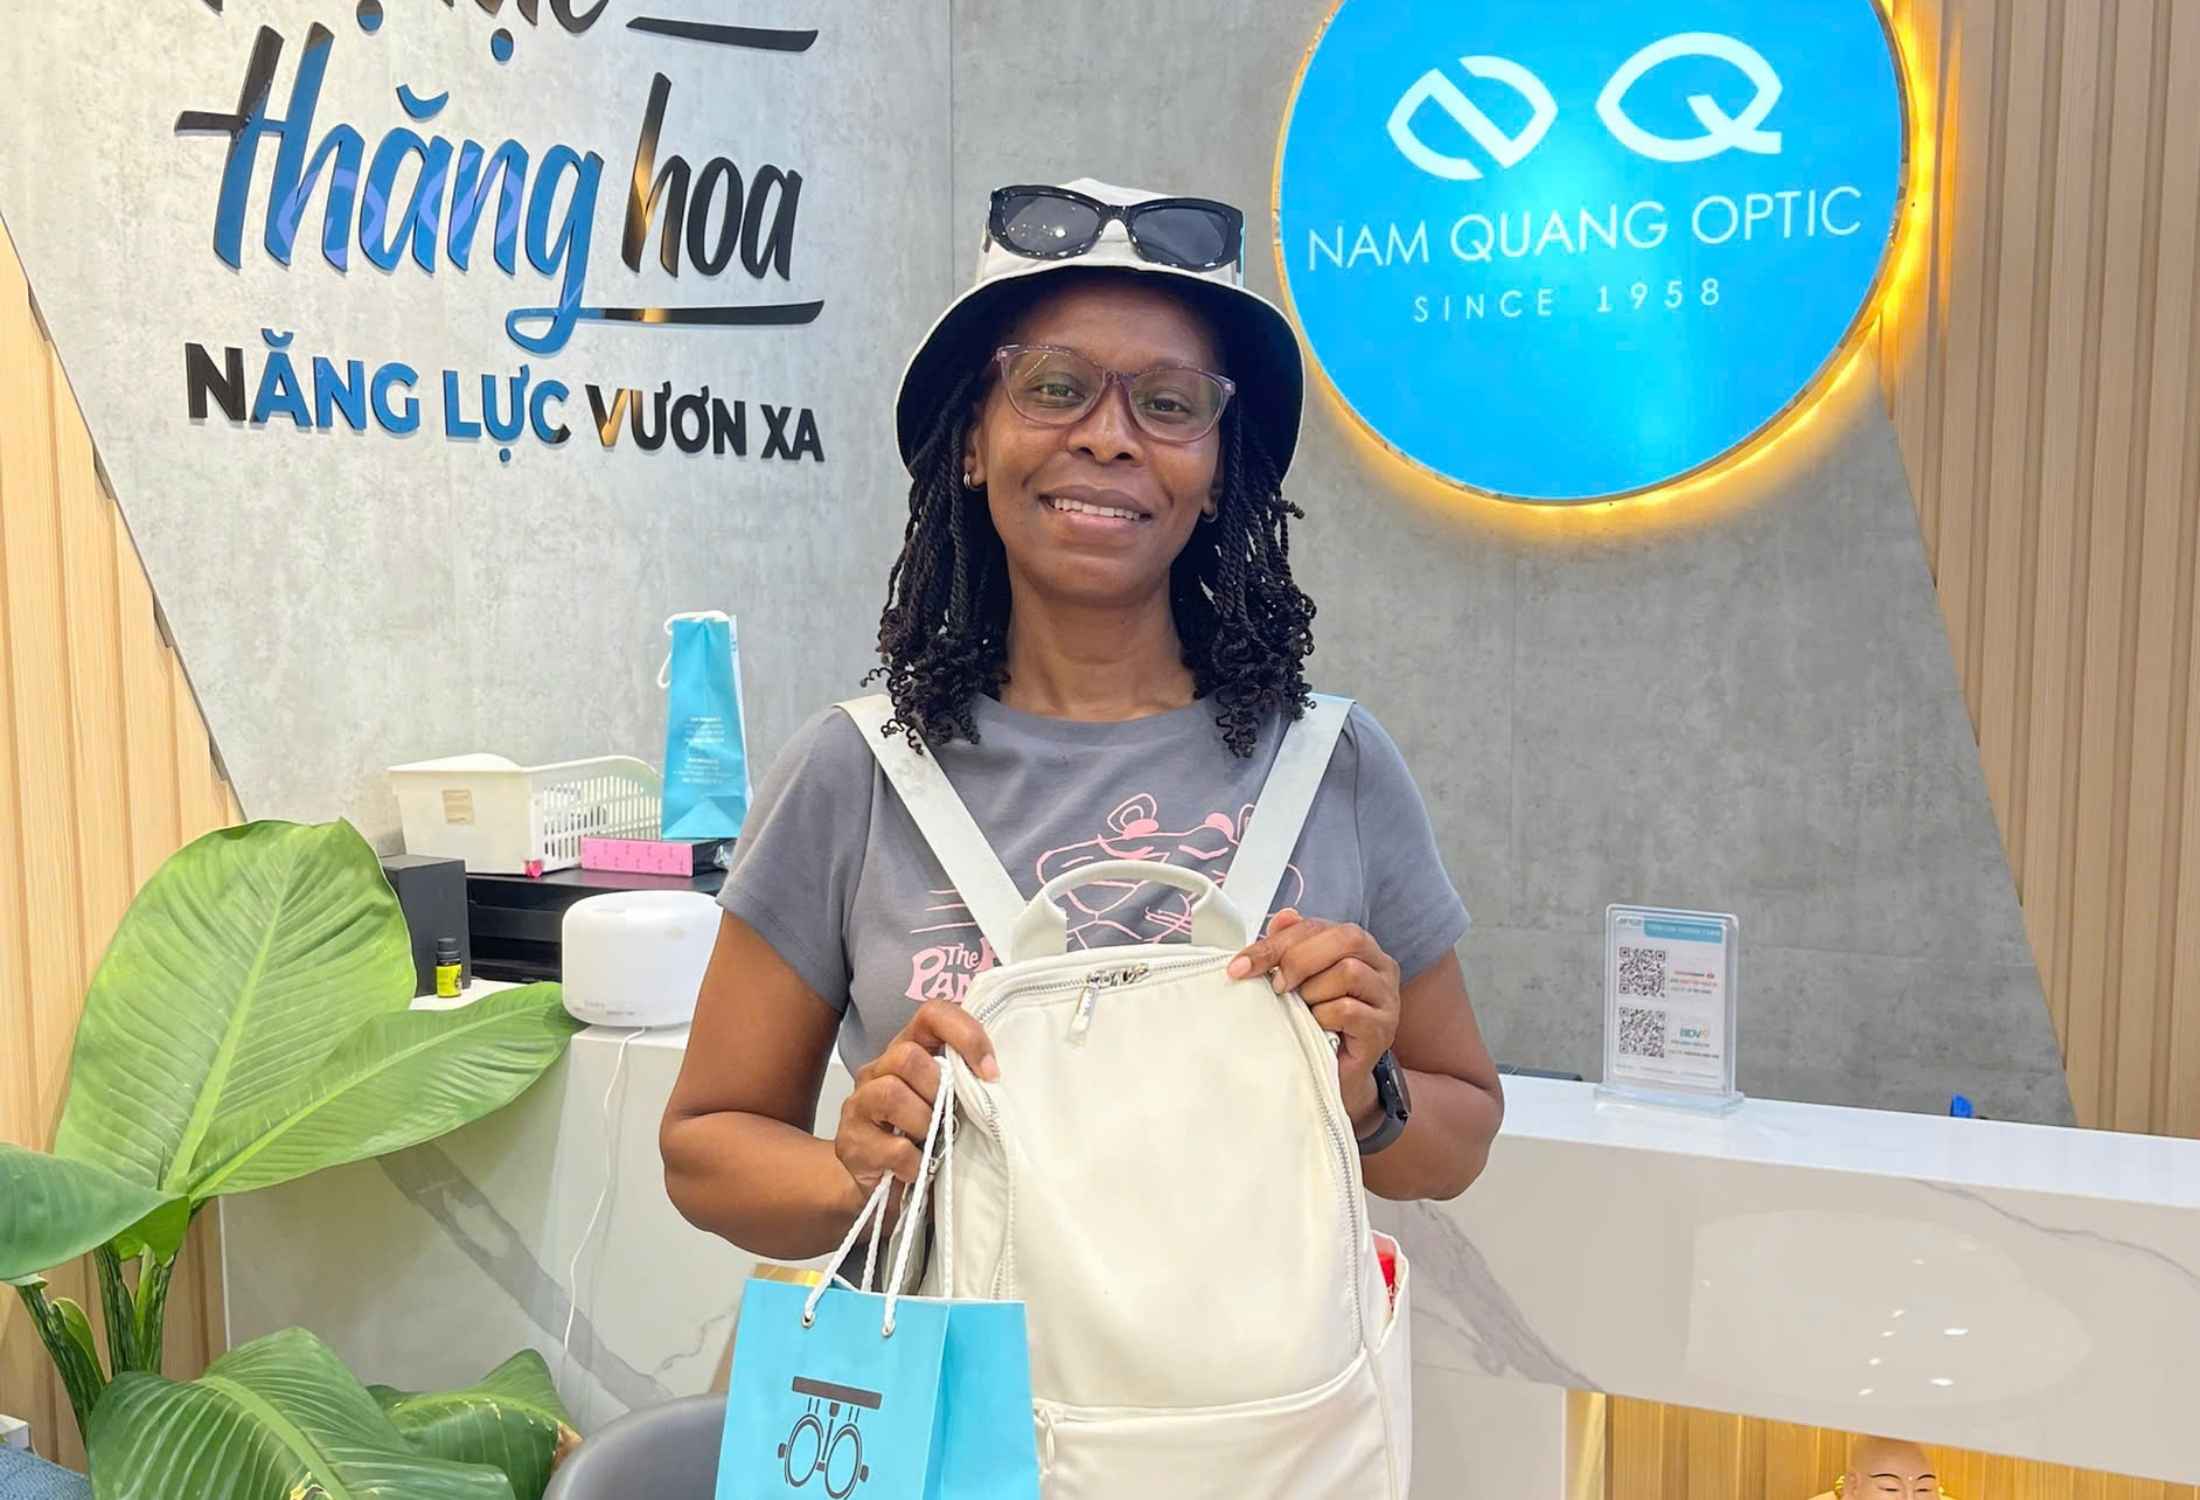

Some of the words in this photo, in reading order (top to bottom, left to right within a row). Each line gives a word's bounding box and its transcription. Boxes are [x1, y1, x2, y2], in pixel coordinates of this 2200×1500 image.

[622, 72, 803, 281] hoa
[1308, 220, 1430, 271] NAM
[1449, 200, 1668, 263] QUANG
[1691, 186, 1862, 245] OPTIC
[1413, 288, 1553, 322] SINCE
[1595, 278, 1721, 314] 1958
[185, 328, 420, 436] NĂNG
[442, 364, 571, 463] LỰC
[585, 381, 747, 456] VƯƠN
[759, 403, 825, 462] XA
[938, 943, 979, 969] The
